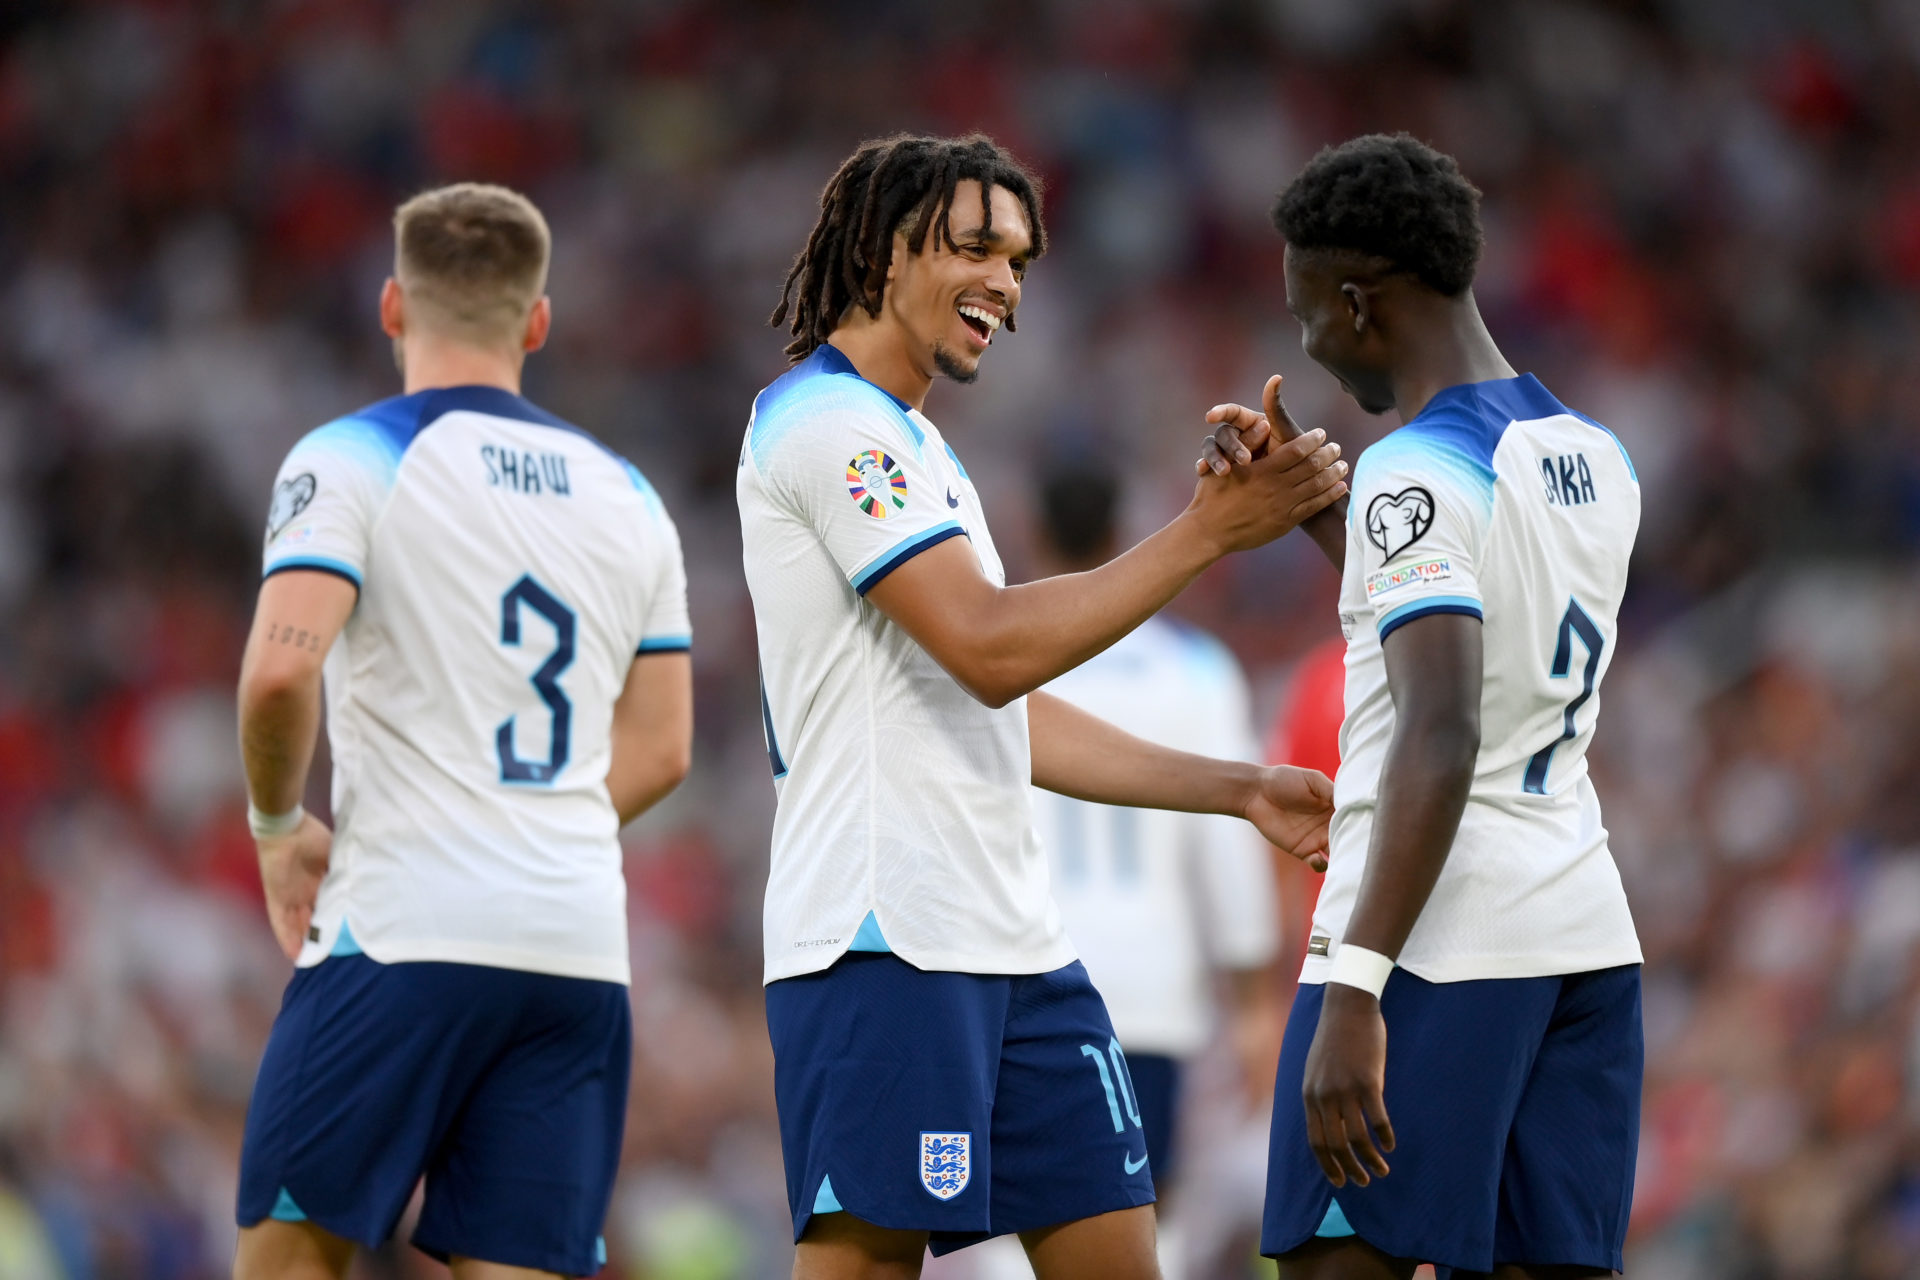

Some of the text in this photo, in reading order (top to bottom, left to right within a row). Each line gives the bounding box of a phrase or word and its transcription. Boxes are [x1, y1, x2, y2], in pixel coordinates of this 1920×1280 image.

[480, 445, 571, 497] SHAW
[1368, 562, 1450, 595] FOUNDATION
[495, 570, 577, 786] 3
[1521, 593, 1605, 795] 7
[1080, 1035, 1142, 1133] 10
